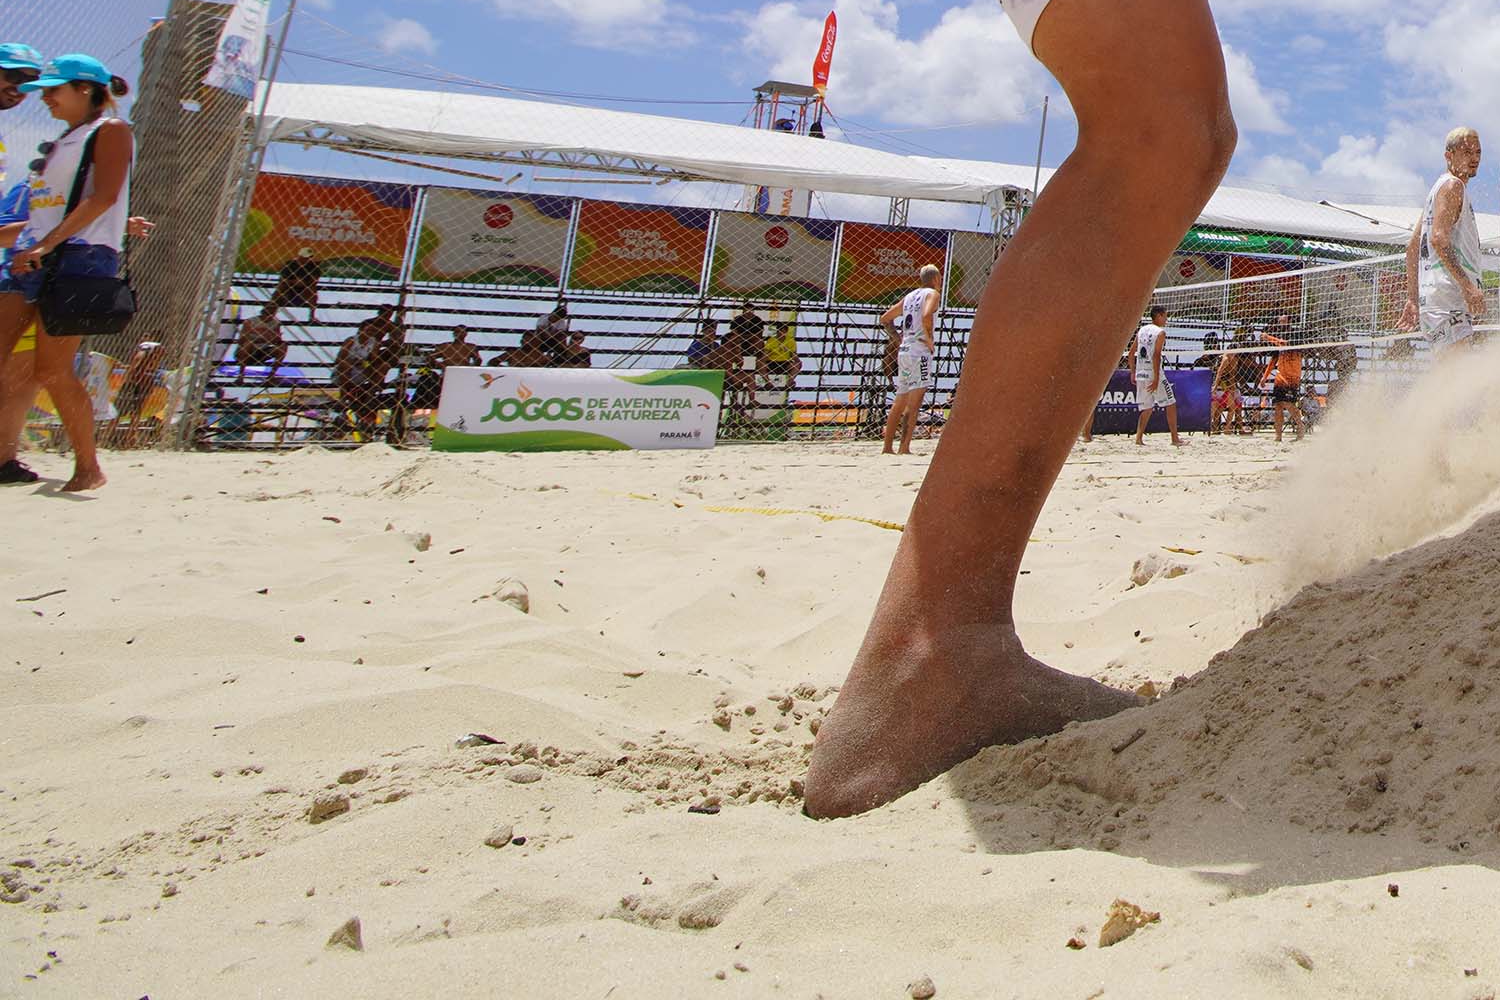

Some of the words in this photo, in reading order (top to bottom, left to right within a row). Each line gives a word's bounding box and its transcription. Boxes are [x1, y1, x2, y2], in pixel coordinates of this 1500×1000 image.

[587, 398, 608, 409] DE
[611, 398, 692, 409] AVENTURA
[480, 397, 585, 423] JOGOS
[586, 409, 595, 421] &
[599, 409, 681, 421] NATUREZA
